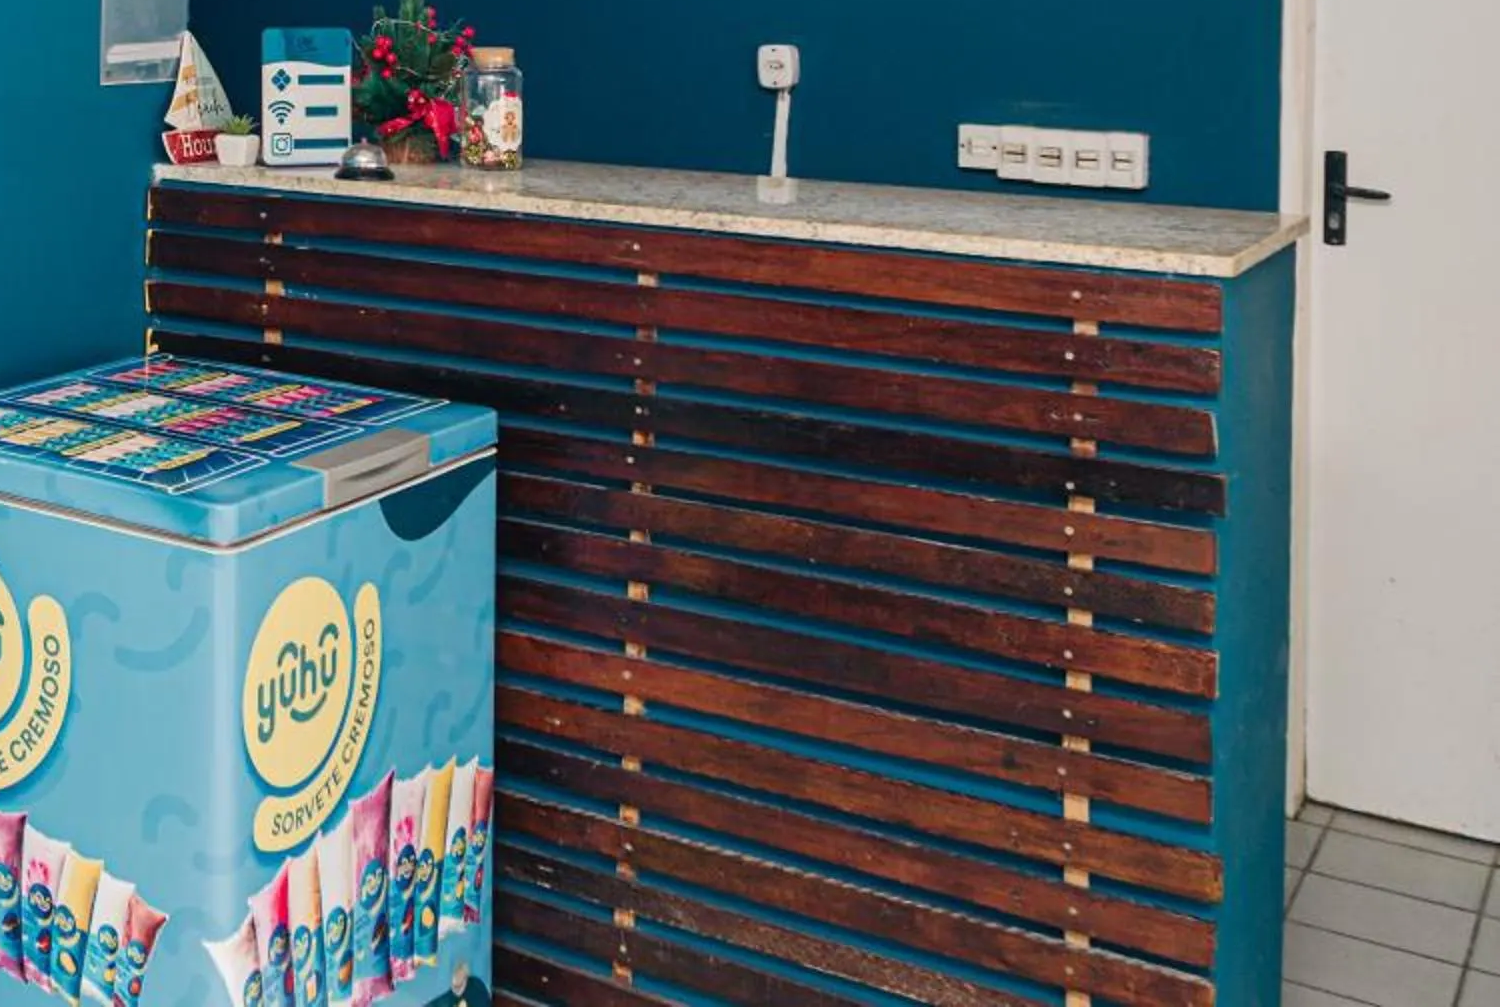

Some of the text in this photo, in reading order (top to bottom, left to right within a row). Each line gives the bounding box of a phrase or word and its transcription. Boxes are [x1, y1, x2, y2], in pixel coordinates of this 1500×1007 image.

[180, 134, 213, 158] Hou
[9, 634, 61, 762] CREMOSO
[271, 618, 376, 836] SORVETE CREMOSO
